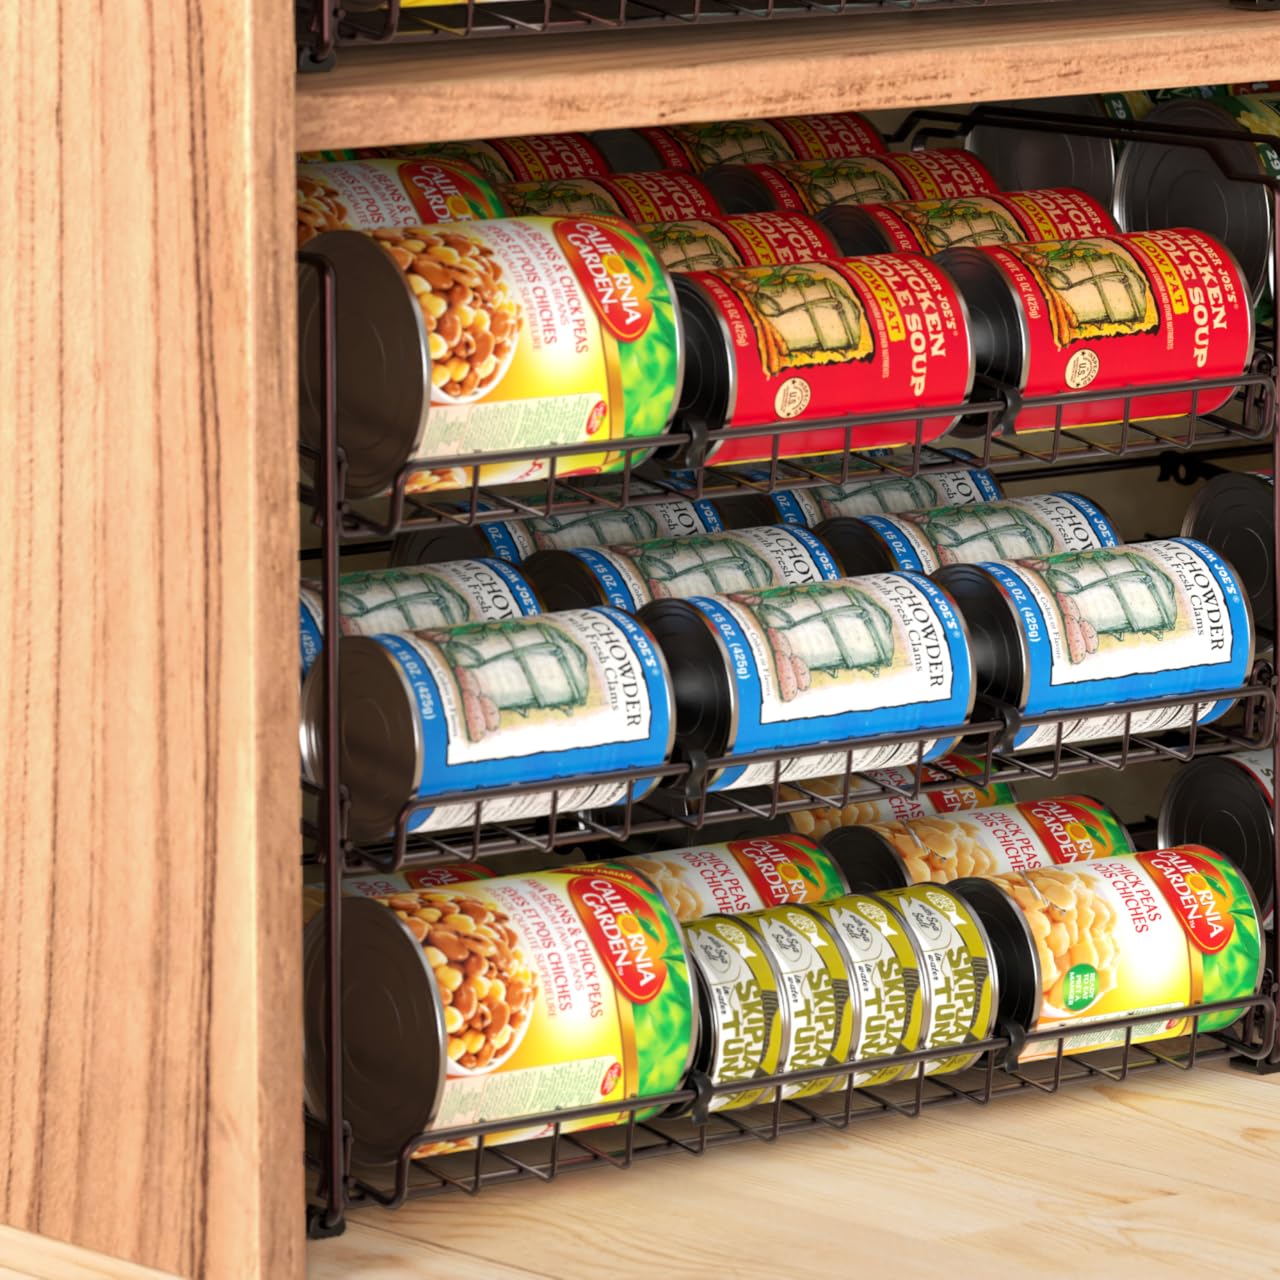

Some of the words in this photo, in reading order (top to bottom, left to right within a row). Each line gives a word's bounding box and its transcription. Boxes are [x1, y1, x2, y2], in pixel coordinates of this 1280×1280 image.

[568, 234, 617, 306] GARDEN
[1158, 230, 1227, 330] CHICKEN
[1165, 271, 1184, 306] FAT
[1219, 268, 1238, 304] JOE'S
[533, 286, 558, 344] CHICHES
[560, 276, 584, 315] CHICK
[572, 319, 589, 353] PEAS
[874, 255, 946, 357] CHICKEN
[882, 297, 901, 333] FAT
[937, 294, 957, 330] JOE'S
[1188, 287, 1210, 368] SOUP
[906, 315, 927, 397] SOUP
[1175, 551, 1225, 651] CHOWDER
[1214, 564, 1237, 595] JOE'S
[892, 580, 944, 688] CHOWDER
[934, 598, 958, 629] JOE'S
[1020, 606, 1042, 643] (425g)
[1190, 594, 1205, 636] Clams
[592, 621, 642, 727] CHOWDER
[634, 635, 657, 667] JOE'S
[728, 642, 751, 680] (425g)
[907, 630, 922, 672] Clams
[603, 668, 619, 711] Clams
[1108, 862, 1145, 890] CHICK
[1138, 888, 1162, 922] PEAS
[1112, 880, 1149, 934] CHICHES
[1151, 859, 1201, 922] GARDEN
[582, 892, 632, 968] GARDEN
[530, 920, 552, 950] POIS
[546, 951, 572, 1012] CHICHES
[573, 933, 599, 979] CHICK
[589, 982, 604, 1018] PEAS
